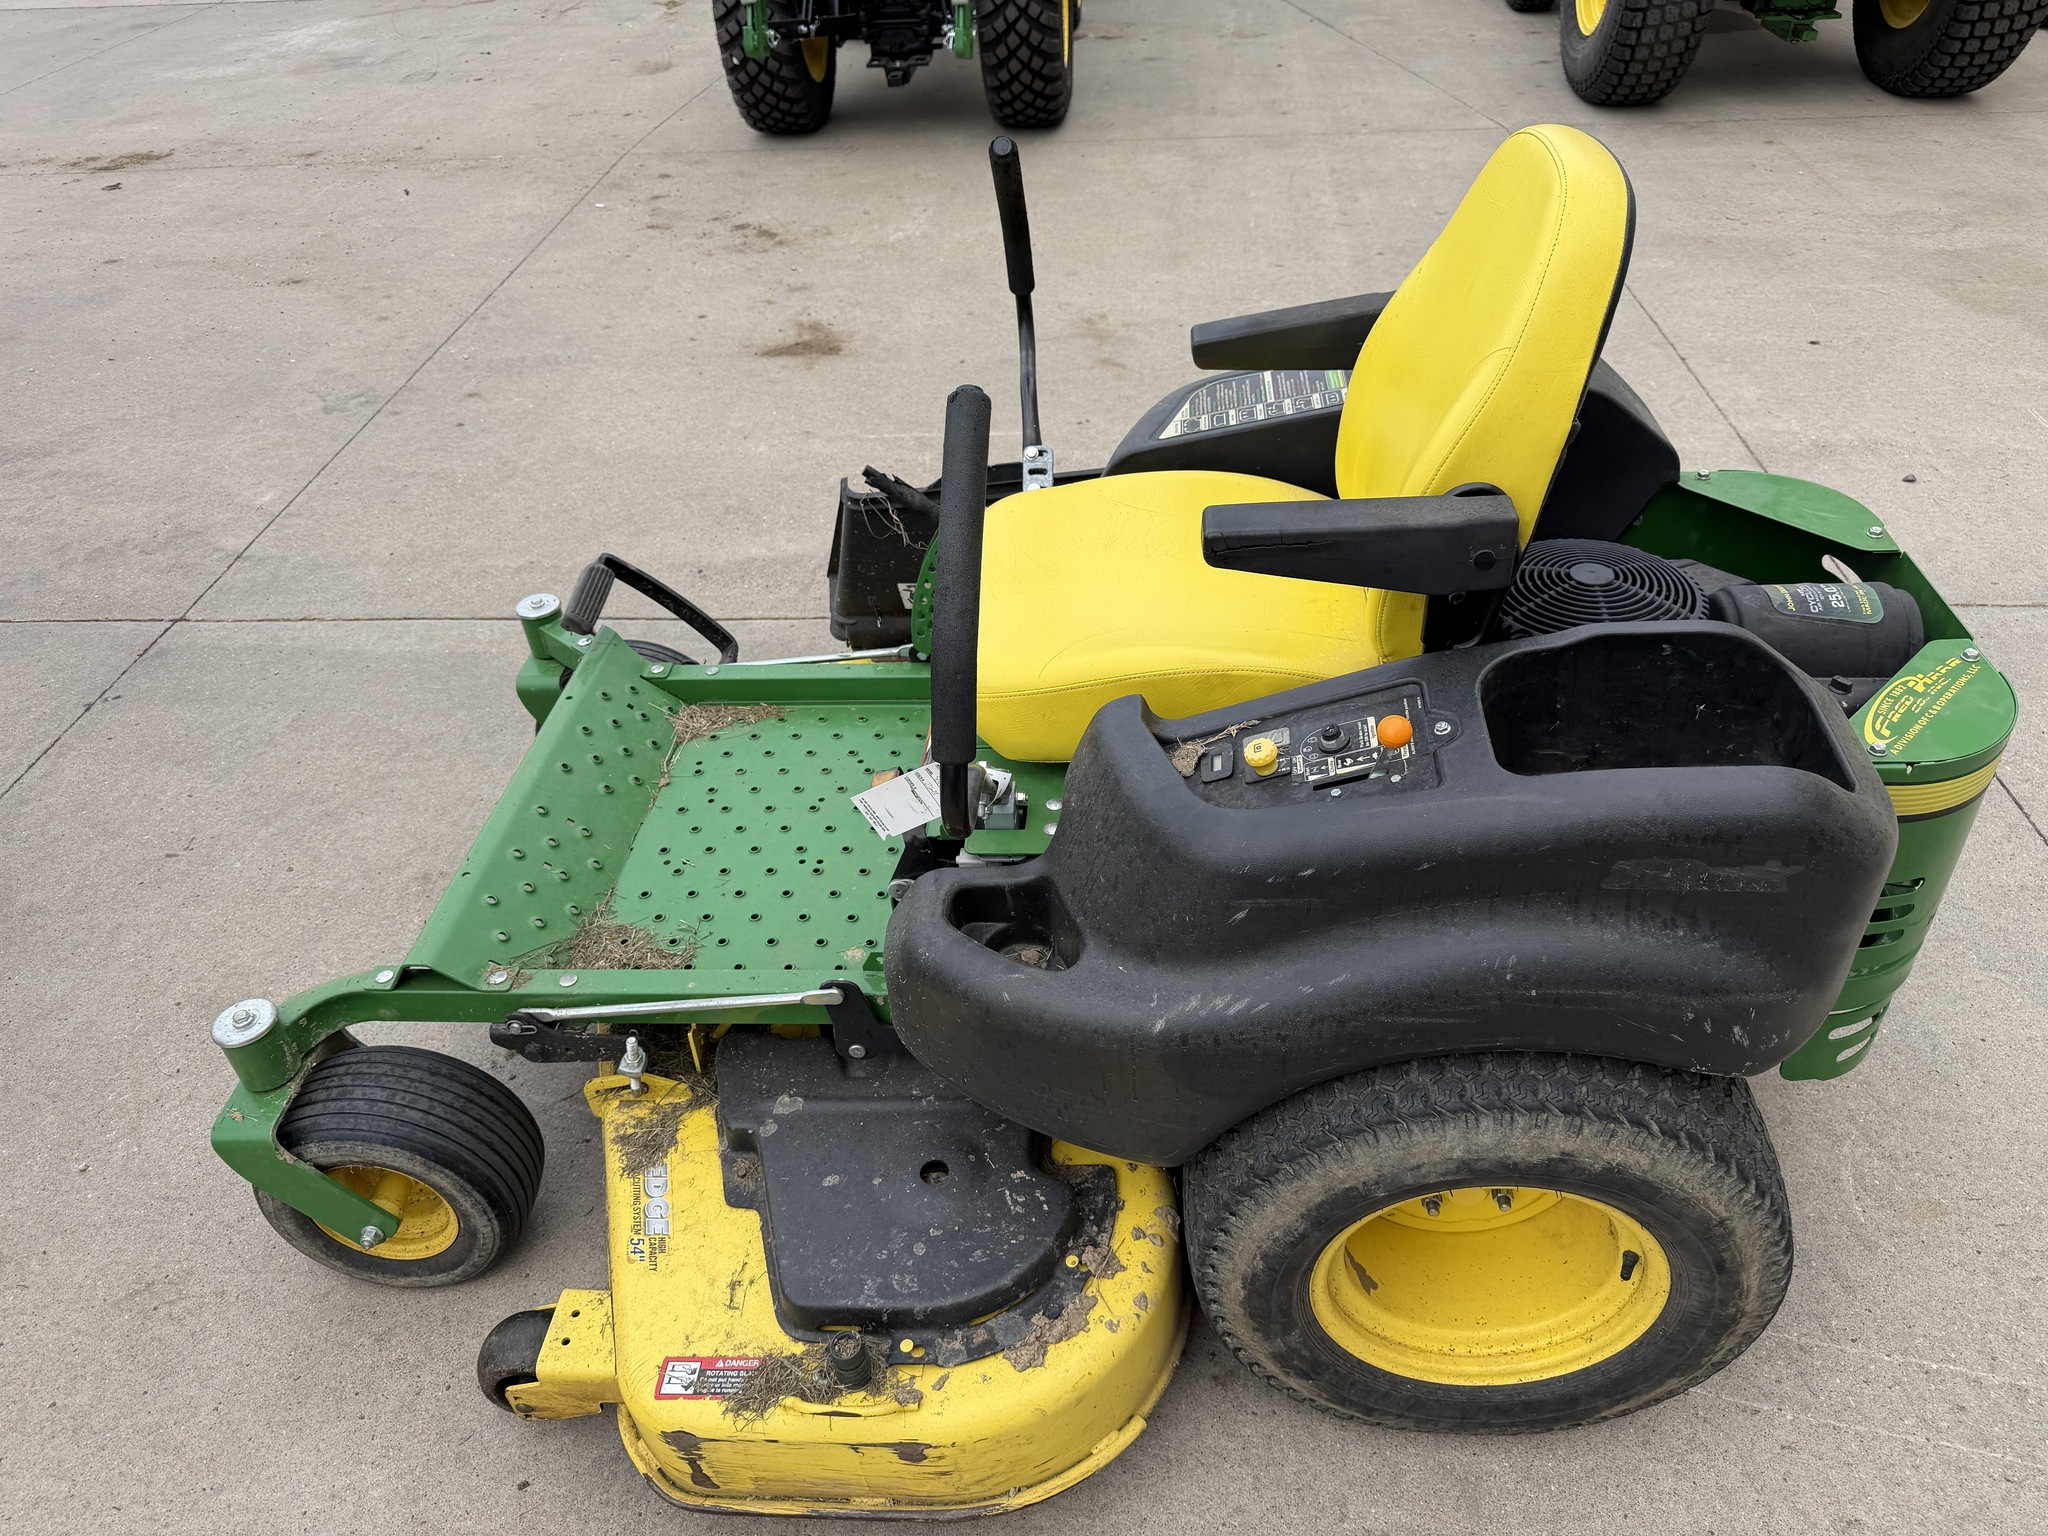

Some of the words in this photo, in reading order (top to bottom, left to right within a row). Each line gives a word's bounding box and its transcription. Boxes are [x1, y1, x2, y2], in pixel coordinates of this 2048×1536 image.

[1784, 593, 1795, 611] JOHN
[1877, 697, 1894, 715] SINCE
[1890, 684, 1908, 698] 1882
[1875, 695, 1914, 738] FRED
[1894, 723, 1923, 751] DIVISION
[632, 1177, 641, 1206] CUTTING
[644, 1163, 670, 1236] EDGE
[632, 1207, 642, 1236] SYSTEM
[629, 1237, 646, 1262] 54"
[648, 1236, 659, 1272] CAPACITY
[657, 1236, 667, 1254] HIGH
[725, 1359, 760, 1368] DANGER
